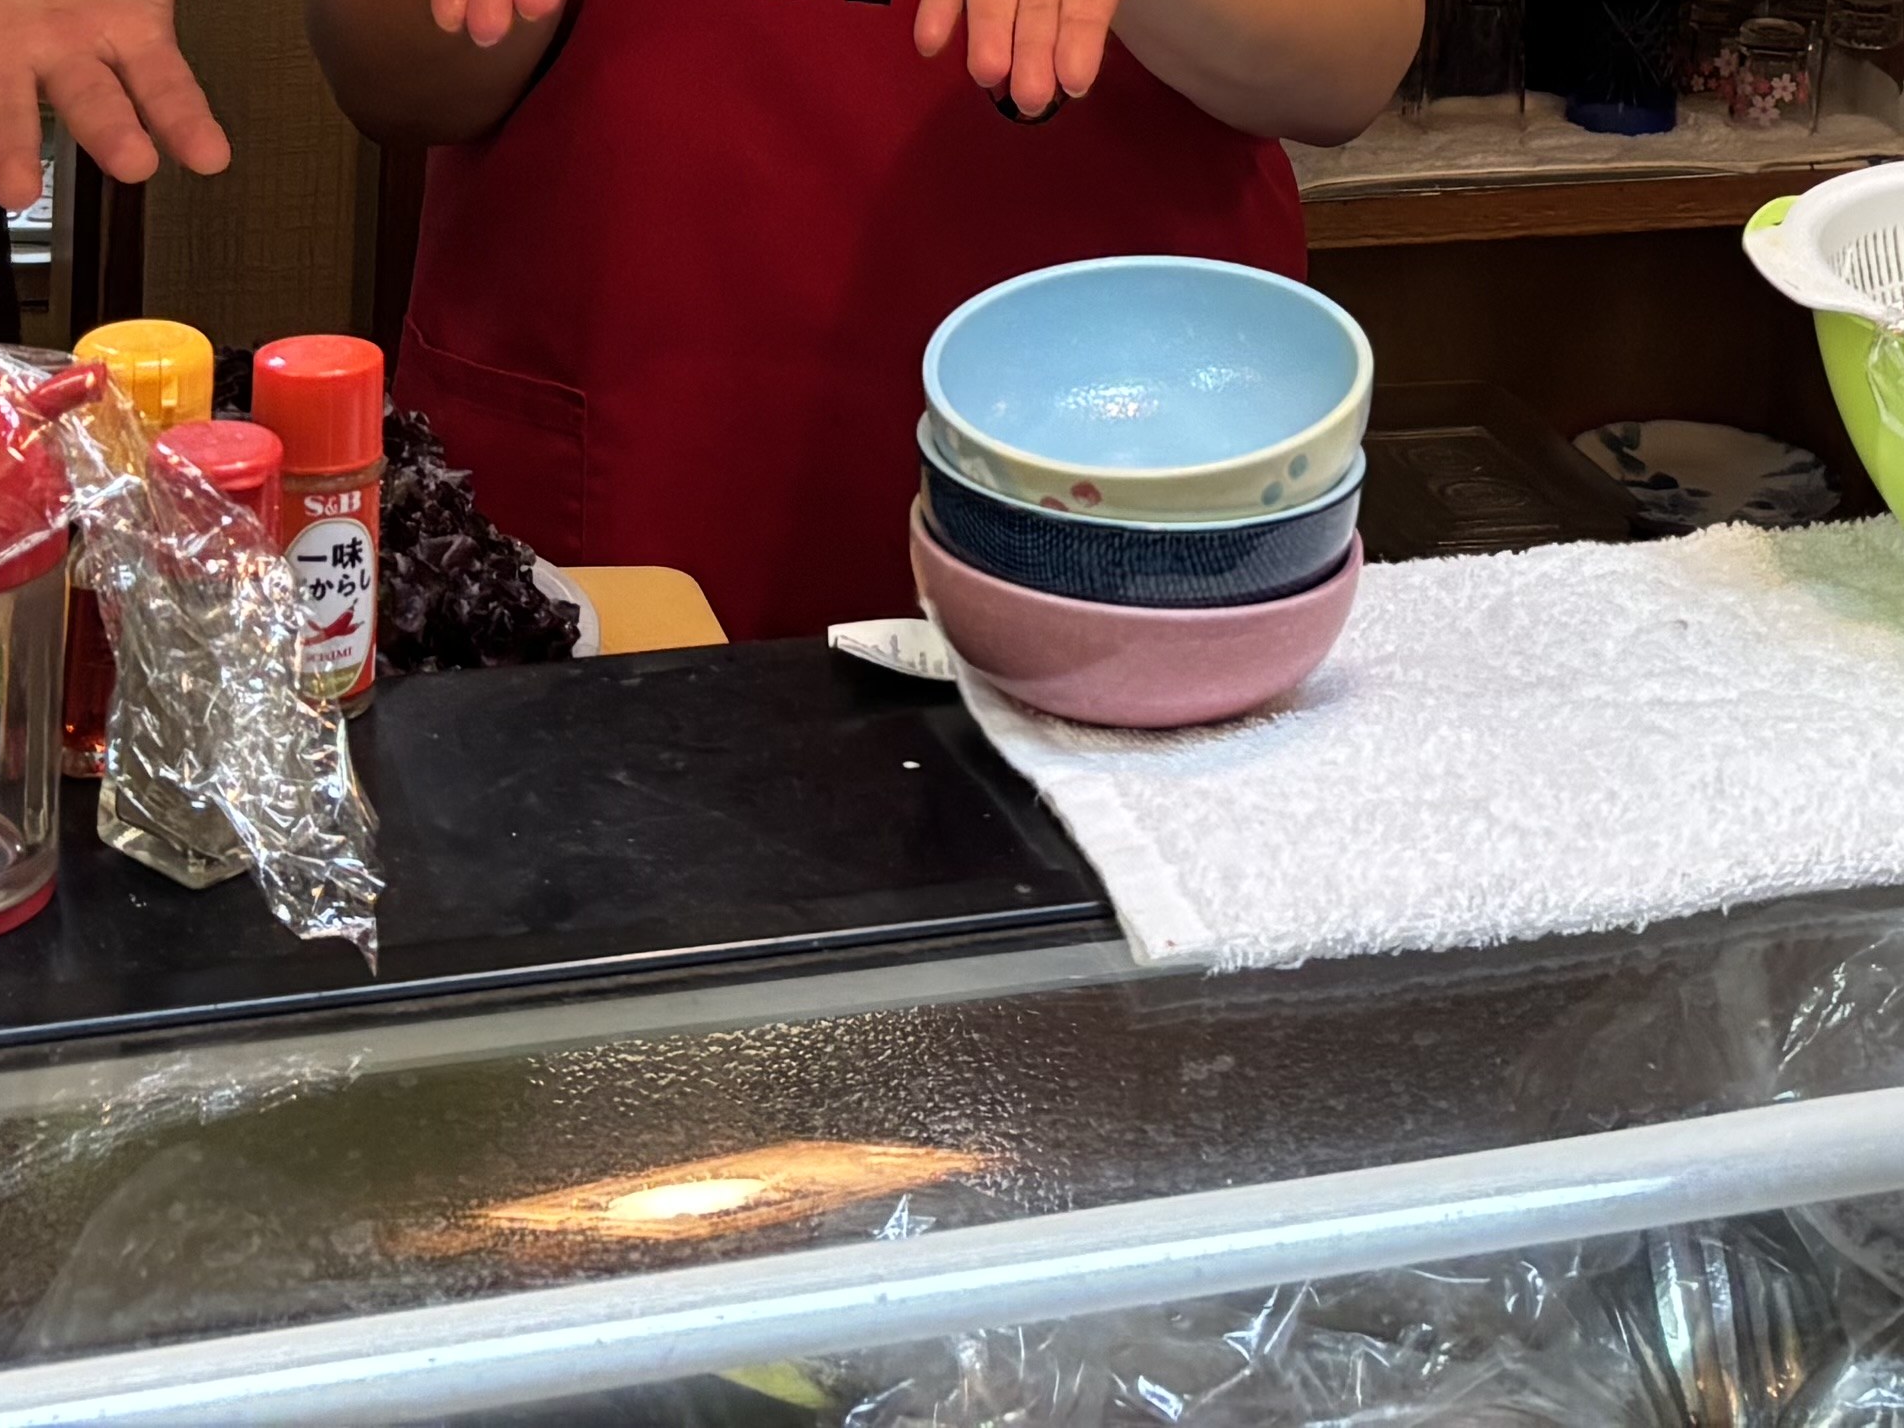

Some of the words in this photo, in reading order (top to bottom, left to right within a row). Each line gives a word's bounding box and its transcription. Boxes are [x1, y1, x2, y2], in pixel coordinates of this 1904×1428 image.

[303, 490, 363, 517] S&B
[297, 536, 364, 570] 一味
[304, 568, 372, 601] からし
